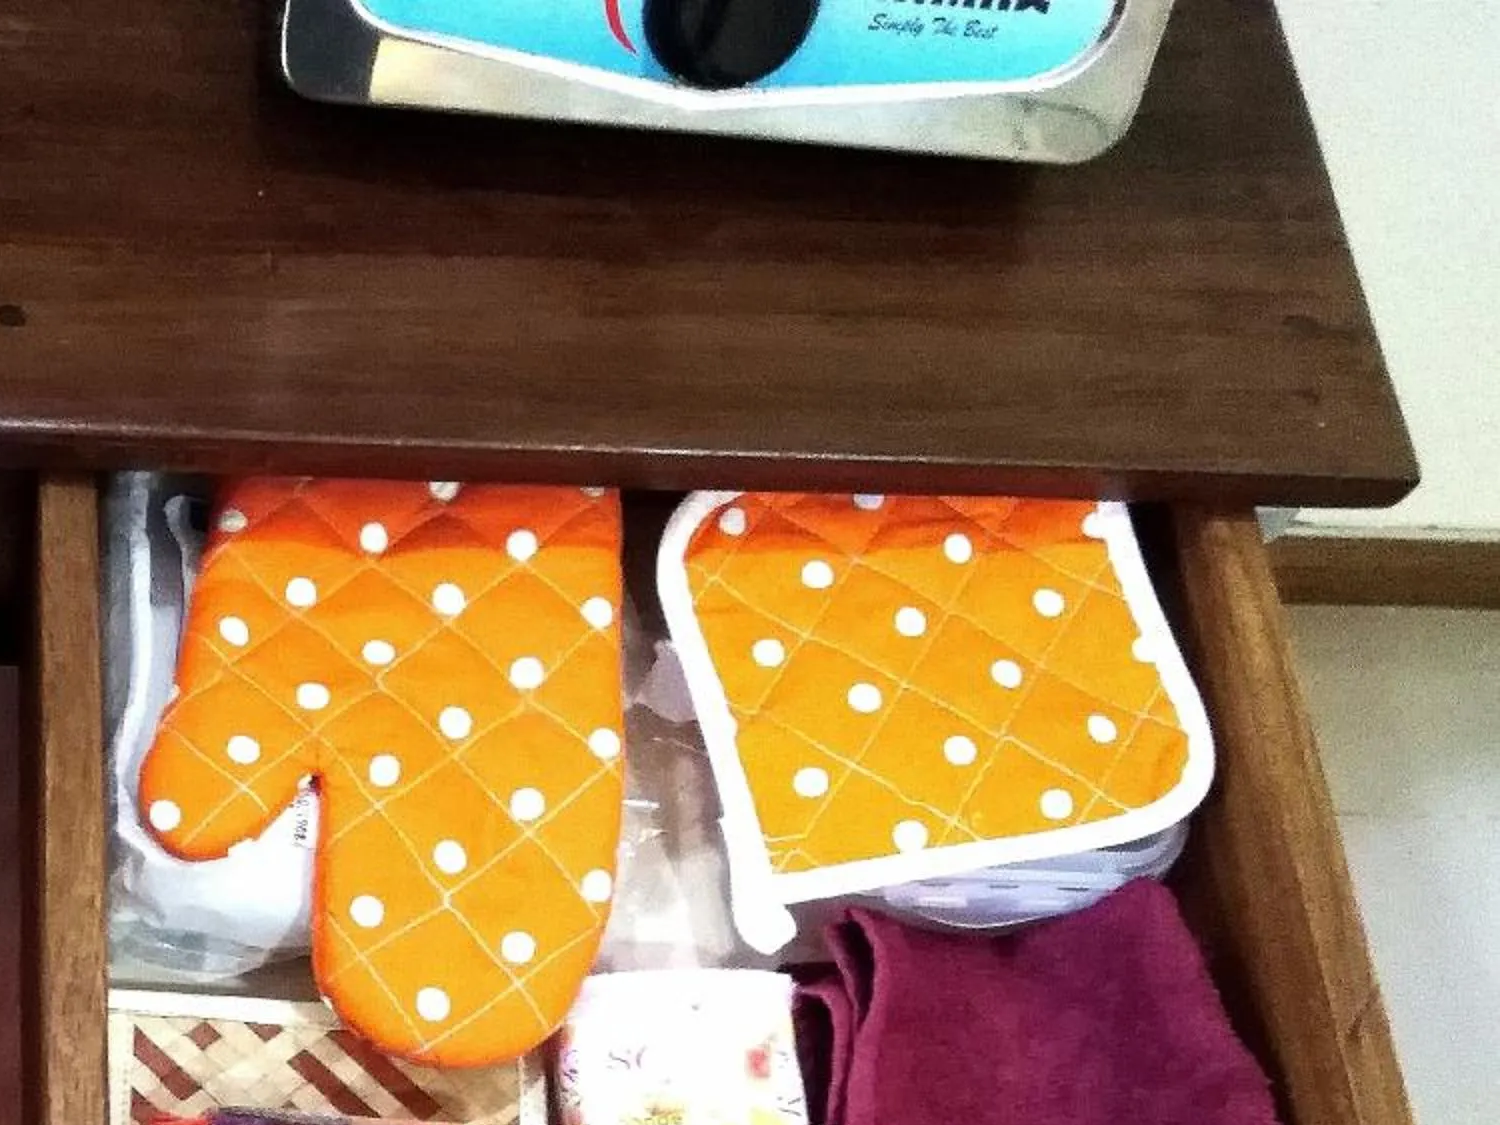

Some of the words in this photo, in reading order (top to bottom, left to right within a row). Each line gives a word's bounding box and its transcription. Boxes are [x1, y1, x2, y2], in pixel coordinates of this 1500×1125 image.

[867, 12, 925, 37] Simply
[931, 16, 958, 37] The
[963, 19, 999, 40] Best
